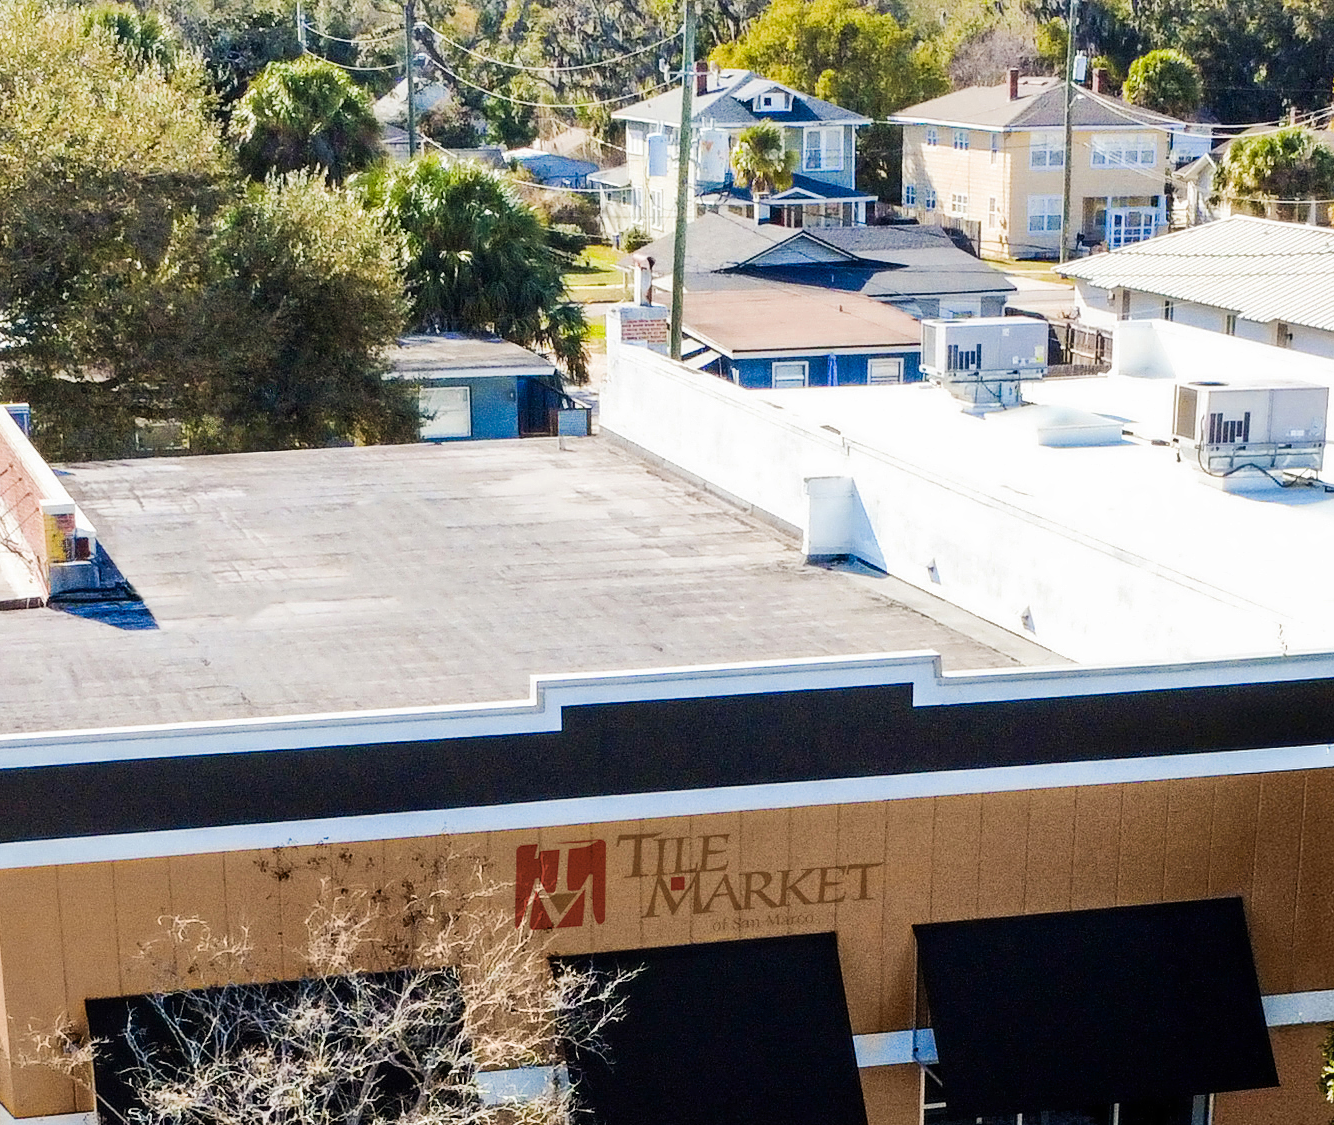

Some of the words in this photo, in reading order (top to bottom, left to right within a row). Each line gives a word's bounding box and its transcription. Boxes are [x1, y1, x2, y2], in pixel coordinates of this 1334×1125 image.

[640, 861, 885, 919] MARKET
[713, 917, 728, 931] of
[768, 914, 814, 926] Marco
